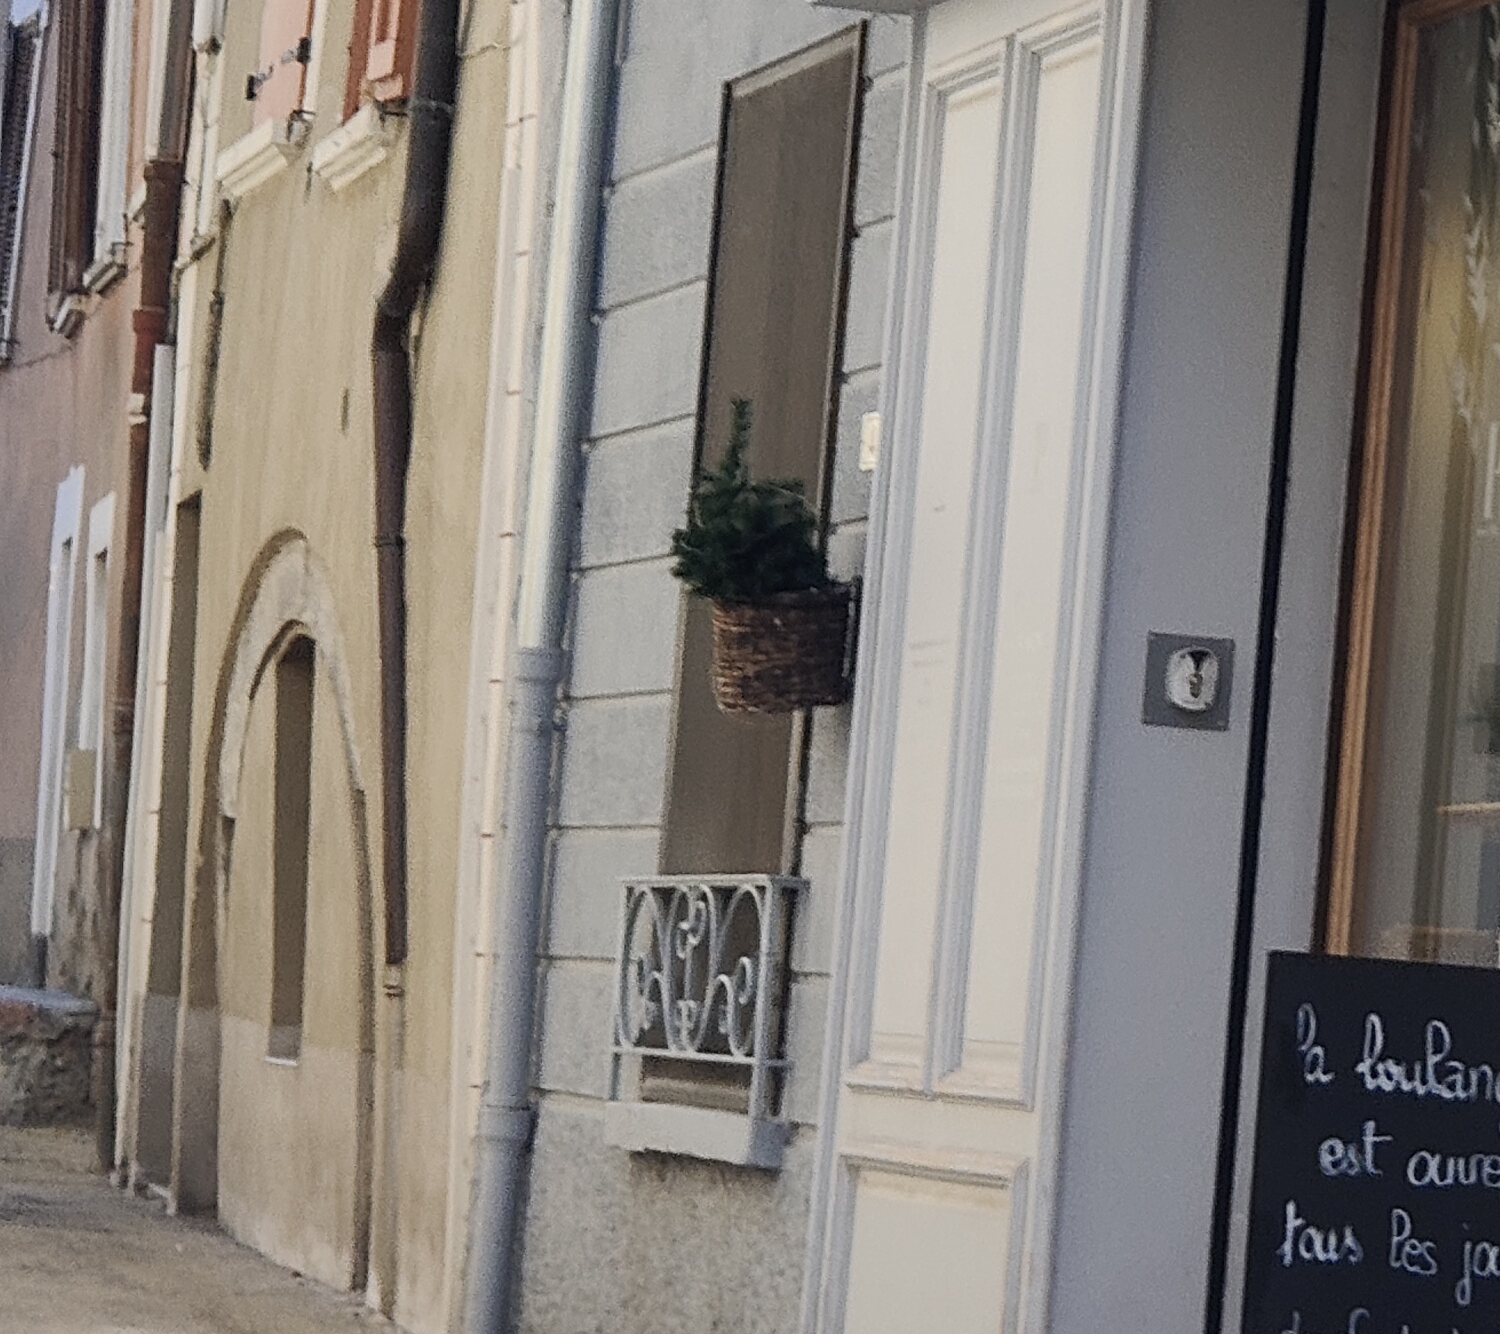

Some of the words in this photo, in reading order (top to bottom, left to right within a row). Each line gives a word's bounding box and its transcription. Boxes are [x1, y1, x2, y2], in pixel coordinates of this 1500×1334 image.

[1296, 1003, 1335, 1084] la
[1317, 1120, 1394, 1177] est
[1278, 1199, 1363, 1267] tous
[1389, 1208, 1438, 1276] les
